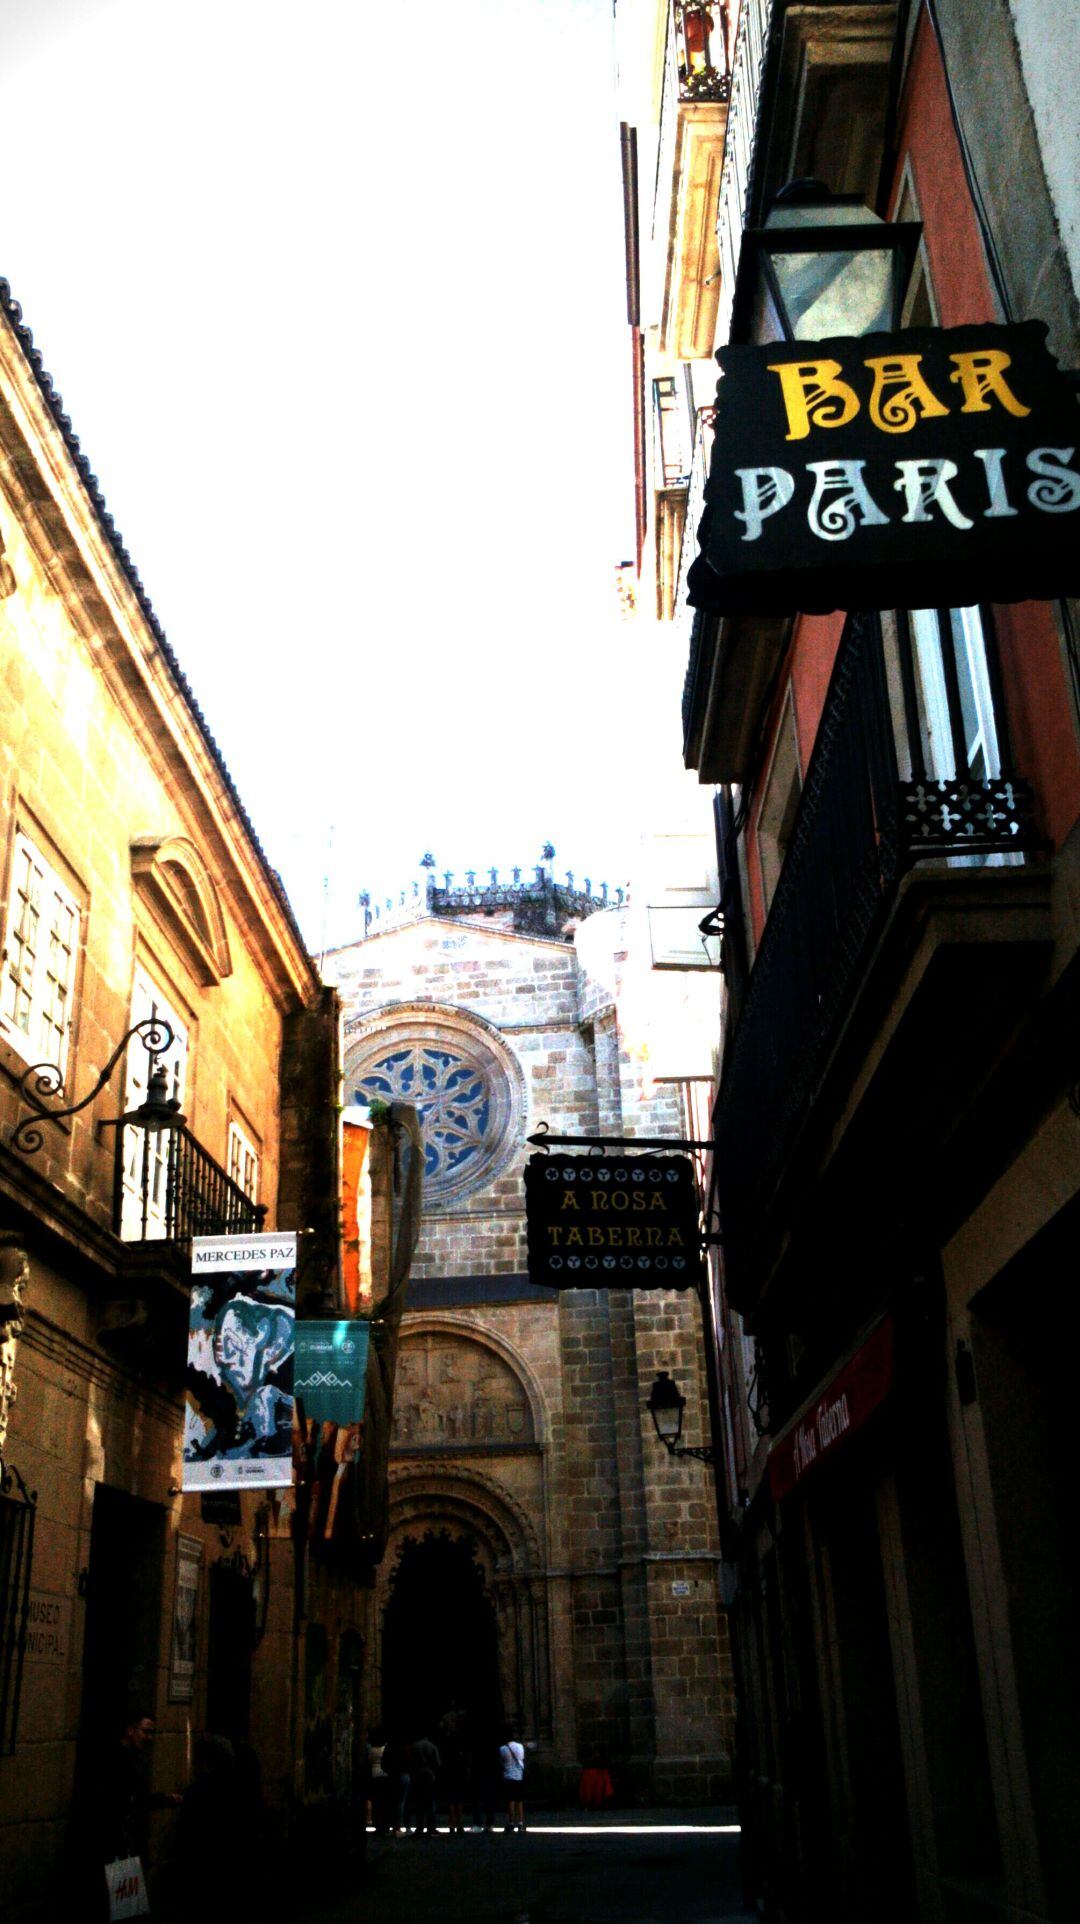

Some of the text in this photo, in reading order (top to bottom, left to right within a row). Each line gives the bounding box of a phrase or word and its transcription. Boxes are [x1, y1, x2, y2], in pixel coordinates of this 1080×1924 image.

[766, 350, 1032, 441] BAR
[733, 447, 1080, 542] PARIS
[560, 1190, 668, 1211] A NOSA
[547, 1226, 685, 1247] TABERNA
[196, 1247, 295, 1263] MERCEDES PAZ
